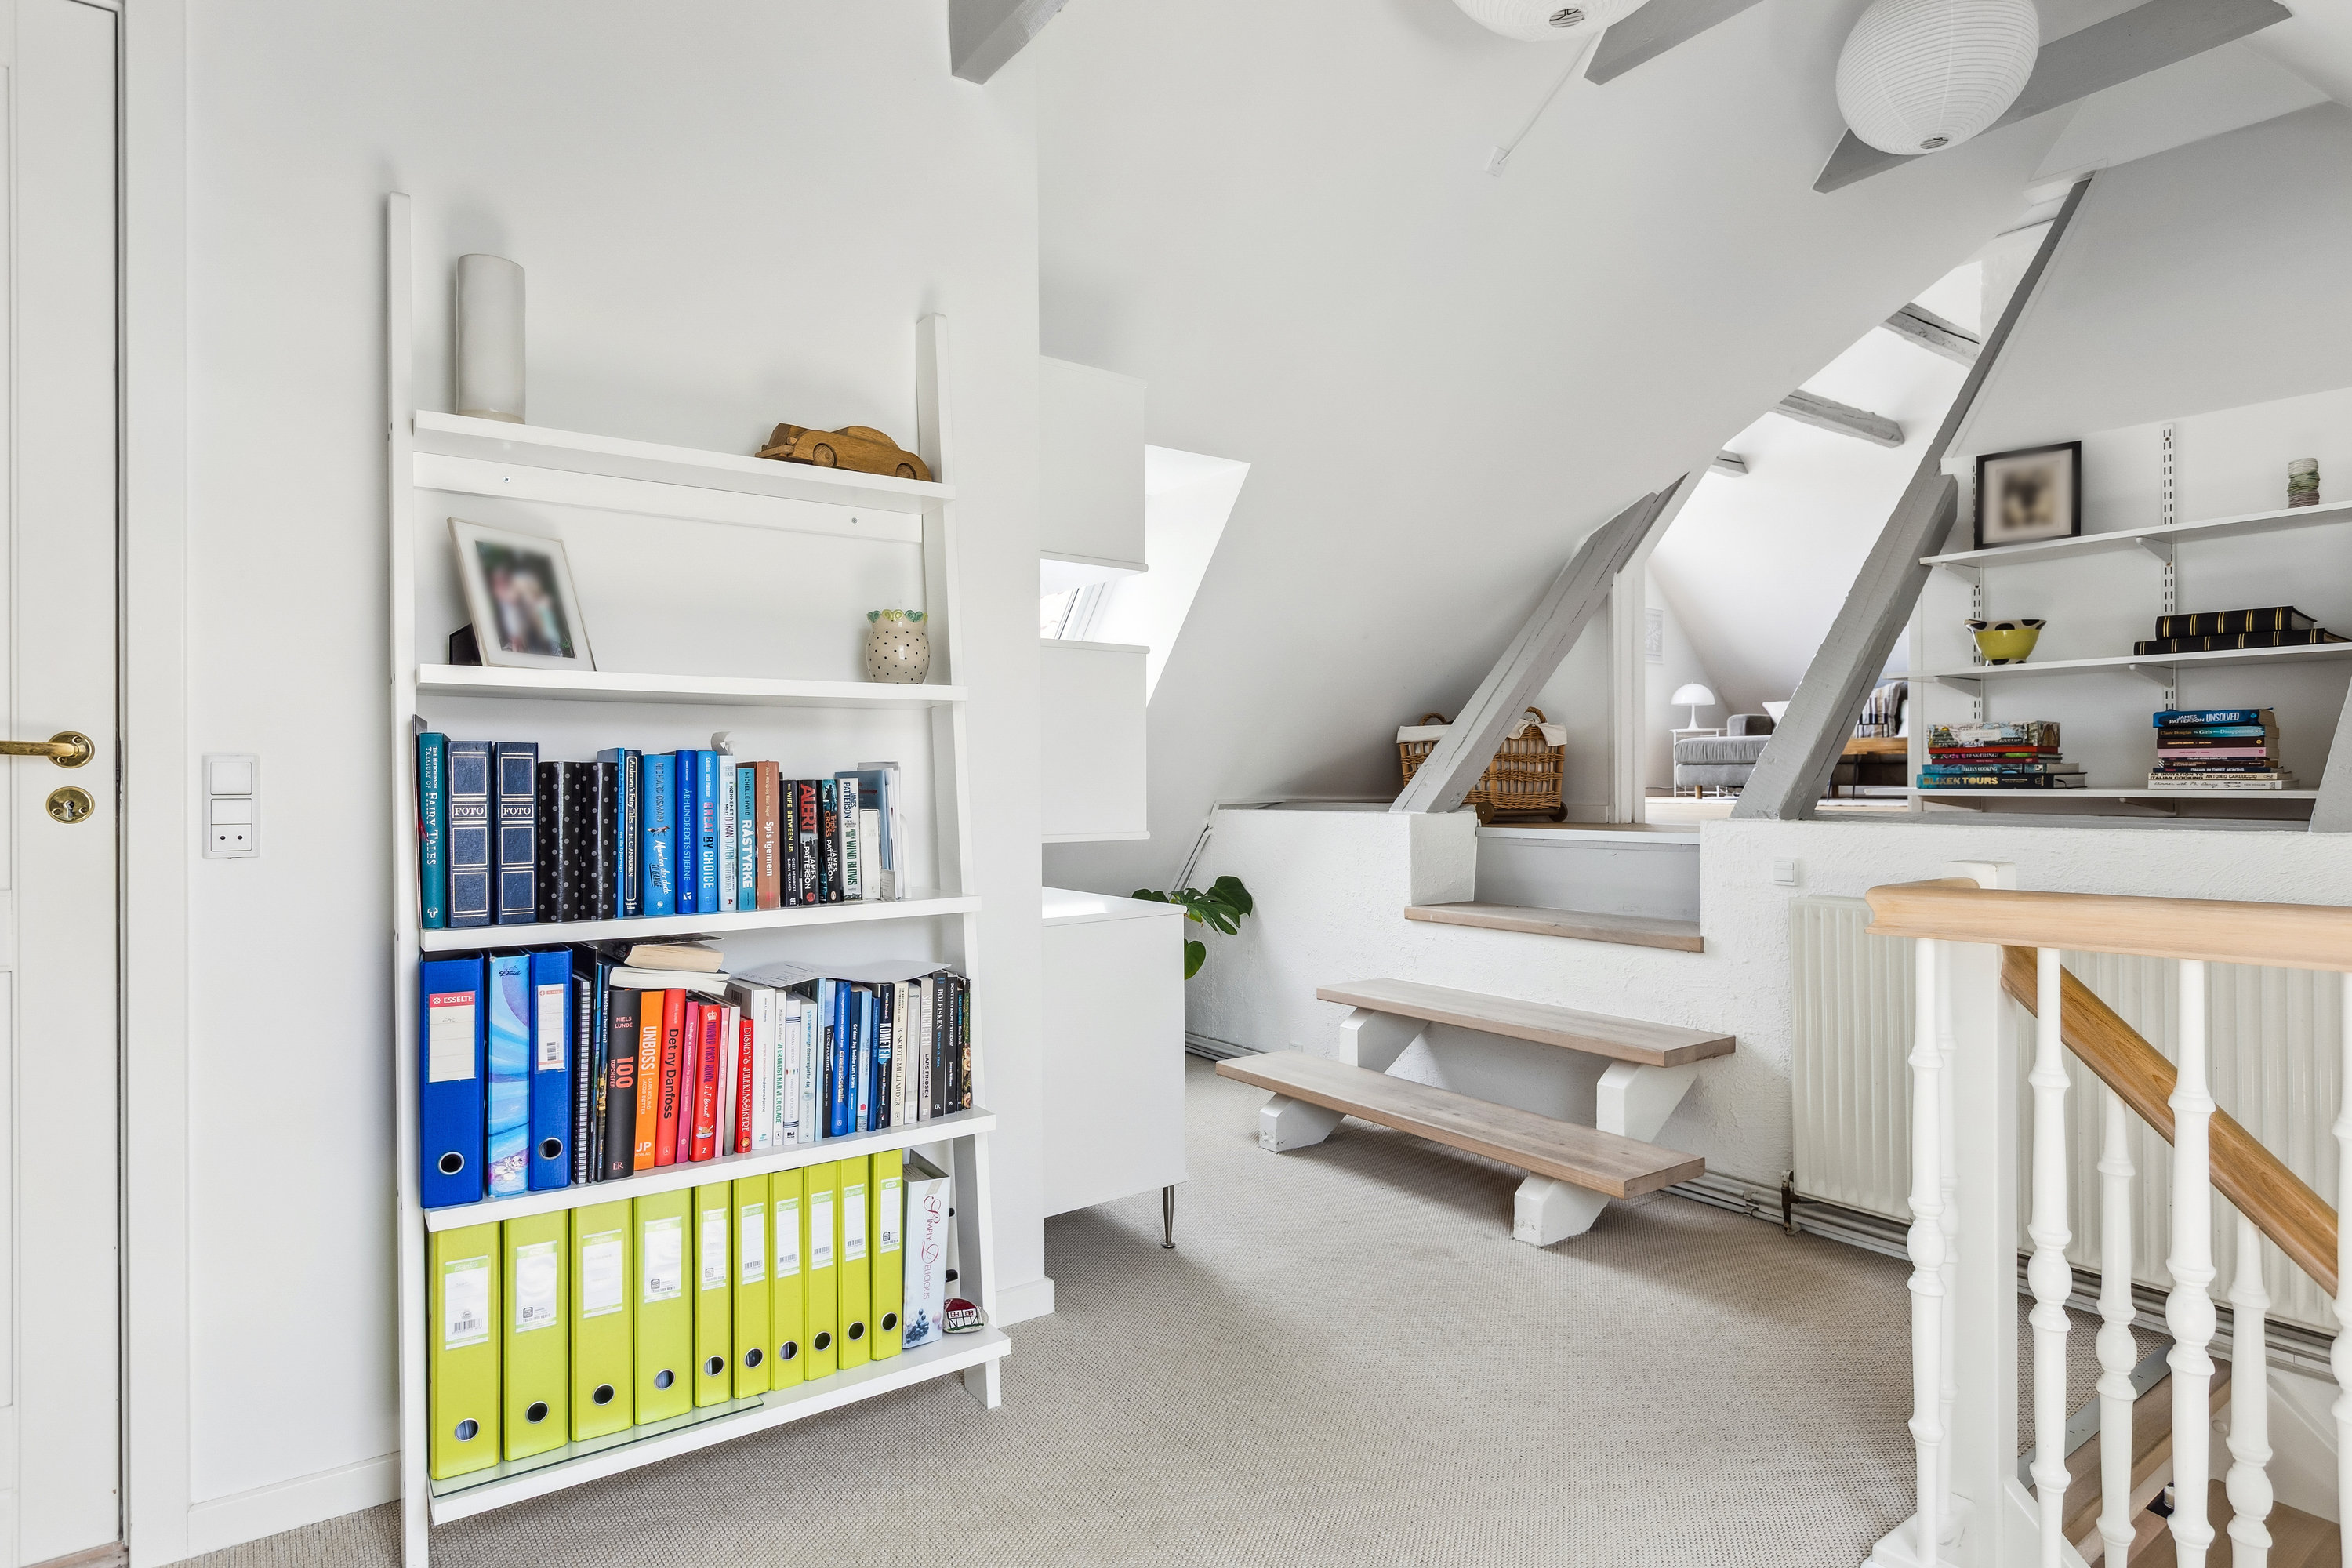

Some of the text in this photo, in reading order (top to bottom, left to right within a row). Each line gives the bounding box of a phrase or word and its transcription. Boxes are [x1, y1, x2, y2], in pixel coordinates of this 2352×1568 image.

[2205, 712, 2239, 722] UNSOLVED
[655, 762, 664, 822] RICHARD OSMAN
[1962, 776, 1998, 785] TOURS
[454, 807, 485, 815] FOTO
[503, 807, 531, 815] FOTO
[684, 789, 692, 849] ÅRHUNDREDETS
[800, 783, 817, 834] ALERT
[426, 792, 438, 865] FAIRY TALES
[724, 817, 734, 837] DUKAN
[654, 840, 666, 866] Manden
[703, 802, 713, 889] GREAT BY CHOICE
[742, 819, 753, 887] RÅSTYRKE
[764, 821, 774, 876] Spis igennem
[788, 844, 794, 852] US
[846, 840, 857, 859] WIND
[652, 870, 661, 887] GANGE
[847, 861, 858, 885] BLOWS
[921, 995, 932, 1046] SPIONCHEFEN
[668, 1029, 679, 1049] Det
[706, 1022, 716, 1045] MURDER
[879, 1022, 891, 1058] KOMETEN
[641, 1025, 657, 1070] UNBOSS
[665, 1053, 676, 1066] ny
[705, 1047, 715, 1063] MOST
[615, 1056, 634, 1088] 100
[703, 1065, 714, 1083] ROYAL
[742, 1027, 752, 1132] DISNEY'S JULEKLASSIKERE
[664, 1069, 676, 1119] Danfoss
[636, 1142, 652, 1152] JP
